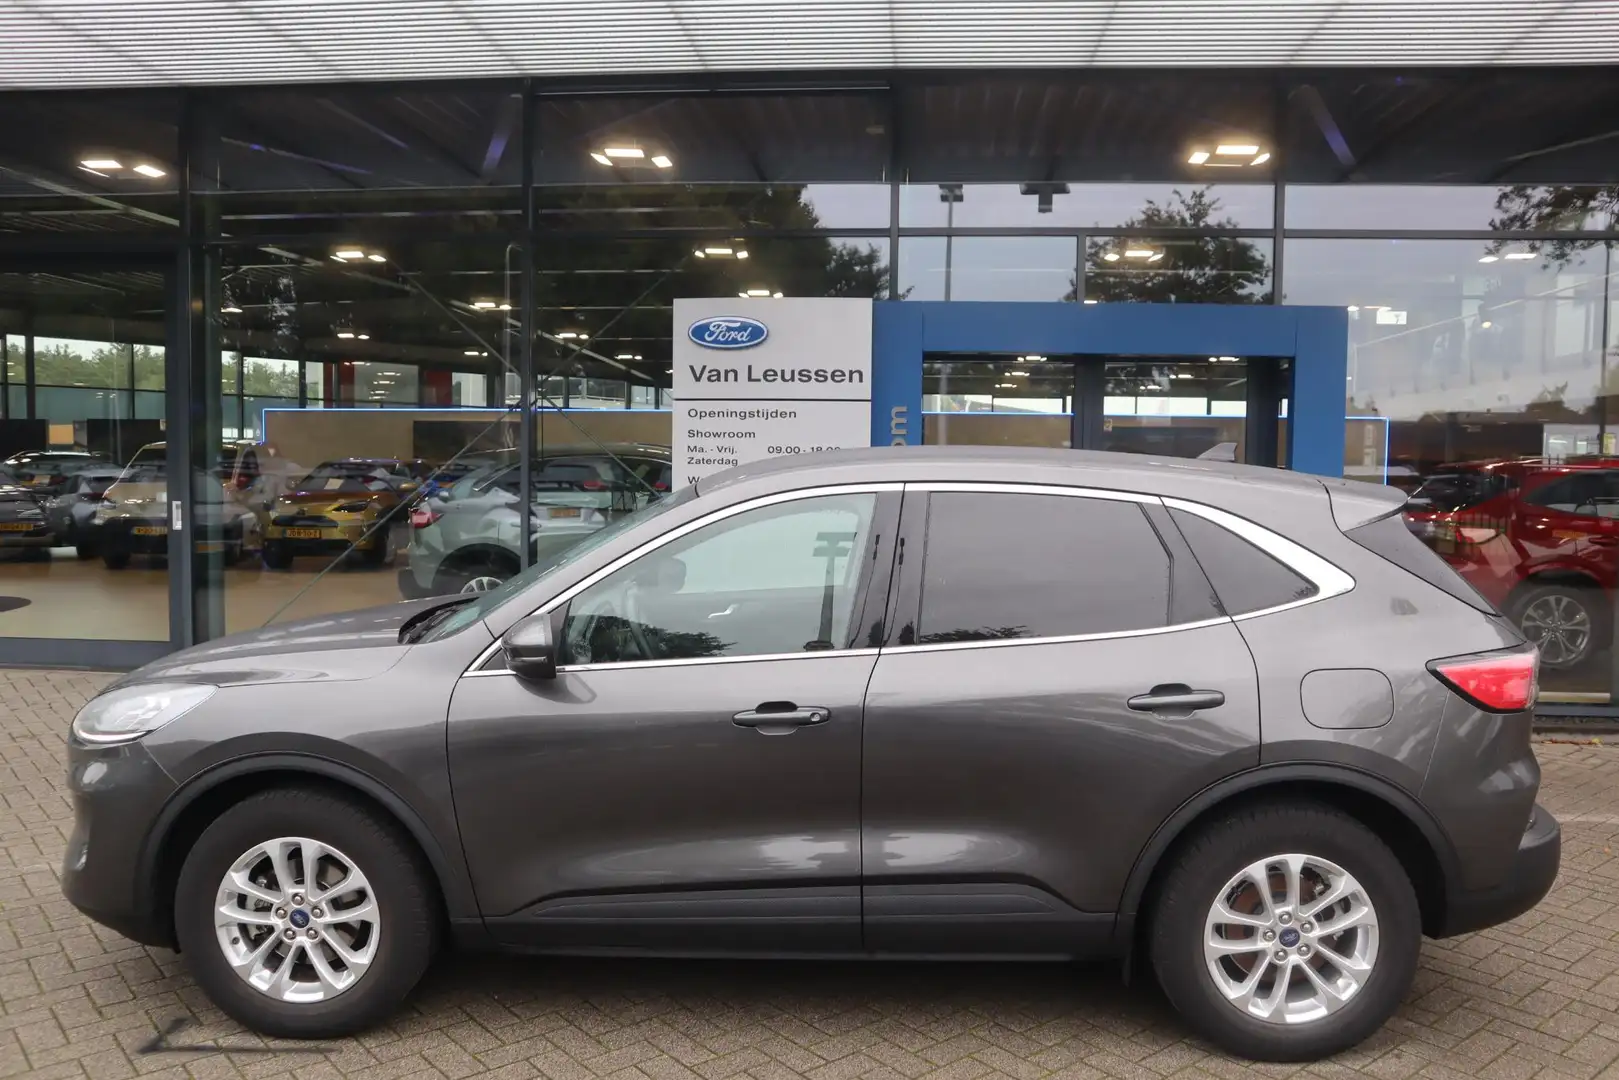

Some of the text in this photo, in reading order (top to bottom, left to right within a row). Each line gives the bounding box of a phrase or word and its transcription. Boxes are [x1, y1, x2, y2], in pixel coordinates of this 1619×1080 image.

[704, 321, 752, 342] Ford
[689, 365, 864, 384] Van Leussen
[687, 408, 797, 420] Openingstijden
[687, 429, 756, 439] Showroom
[687, 445, 708, 453] Ma.
[716, 445, 738, 455] Vrij.
[767, 445, 801, 454] 09.00
[687, 457, 738, 467] Zaterdag
